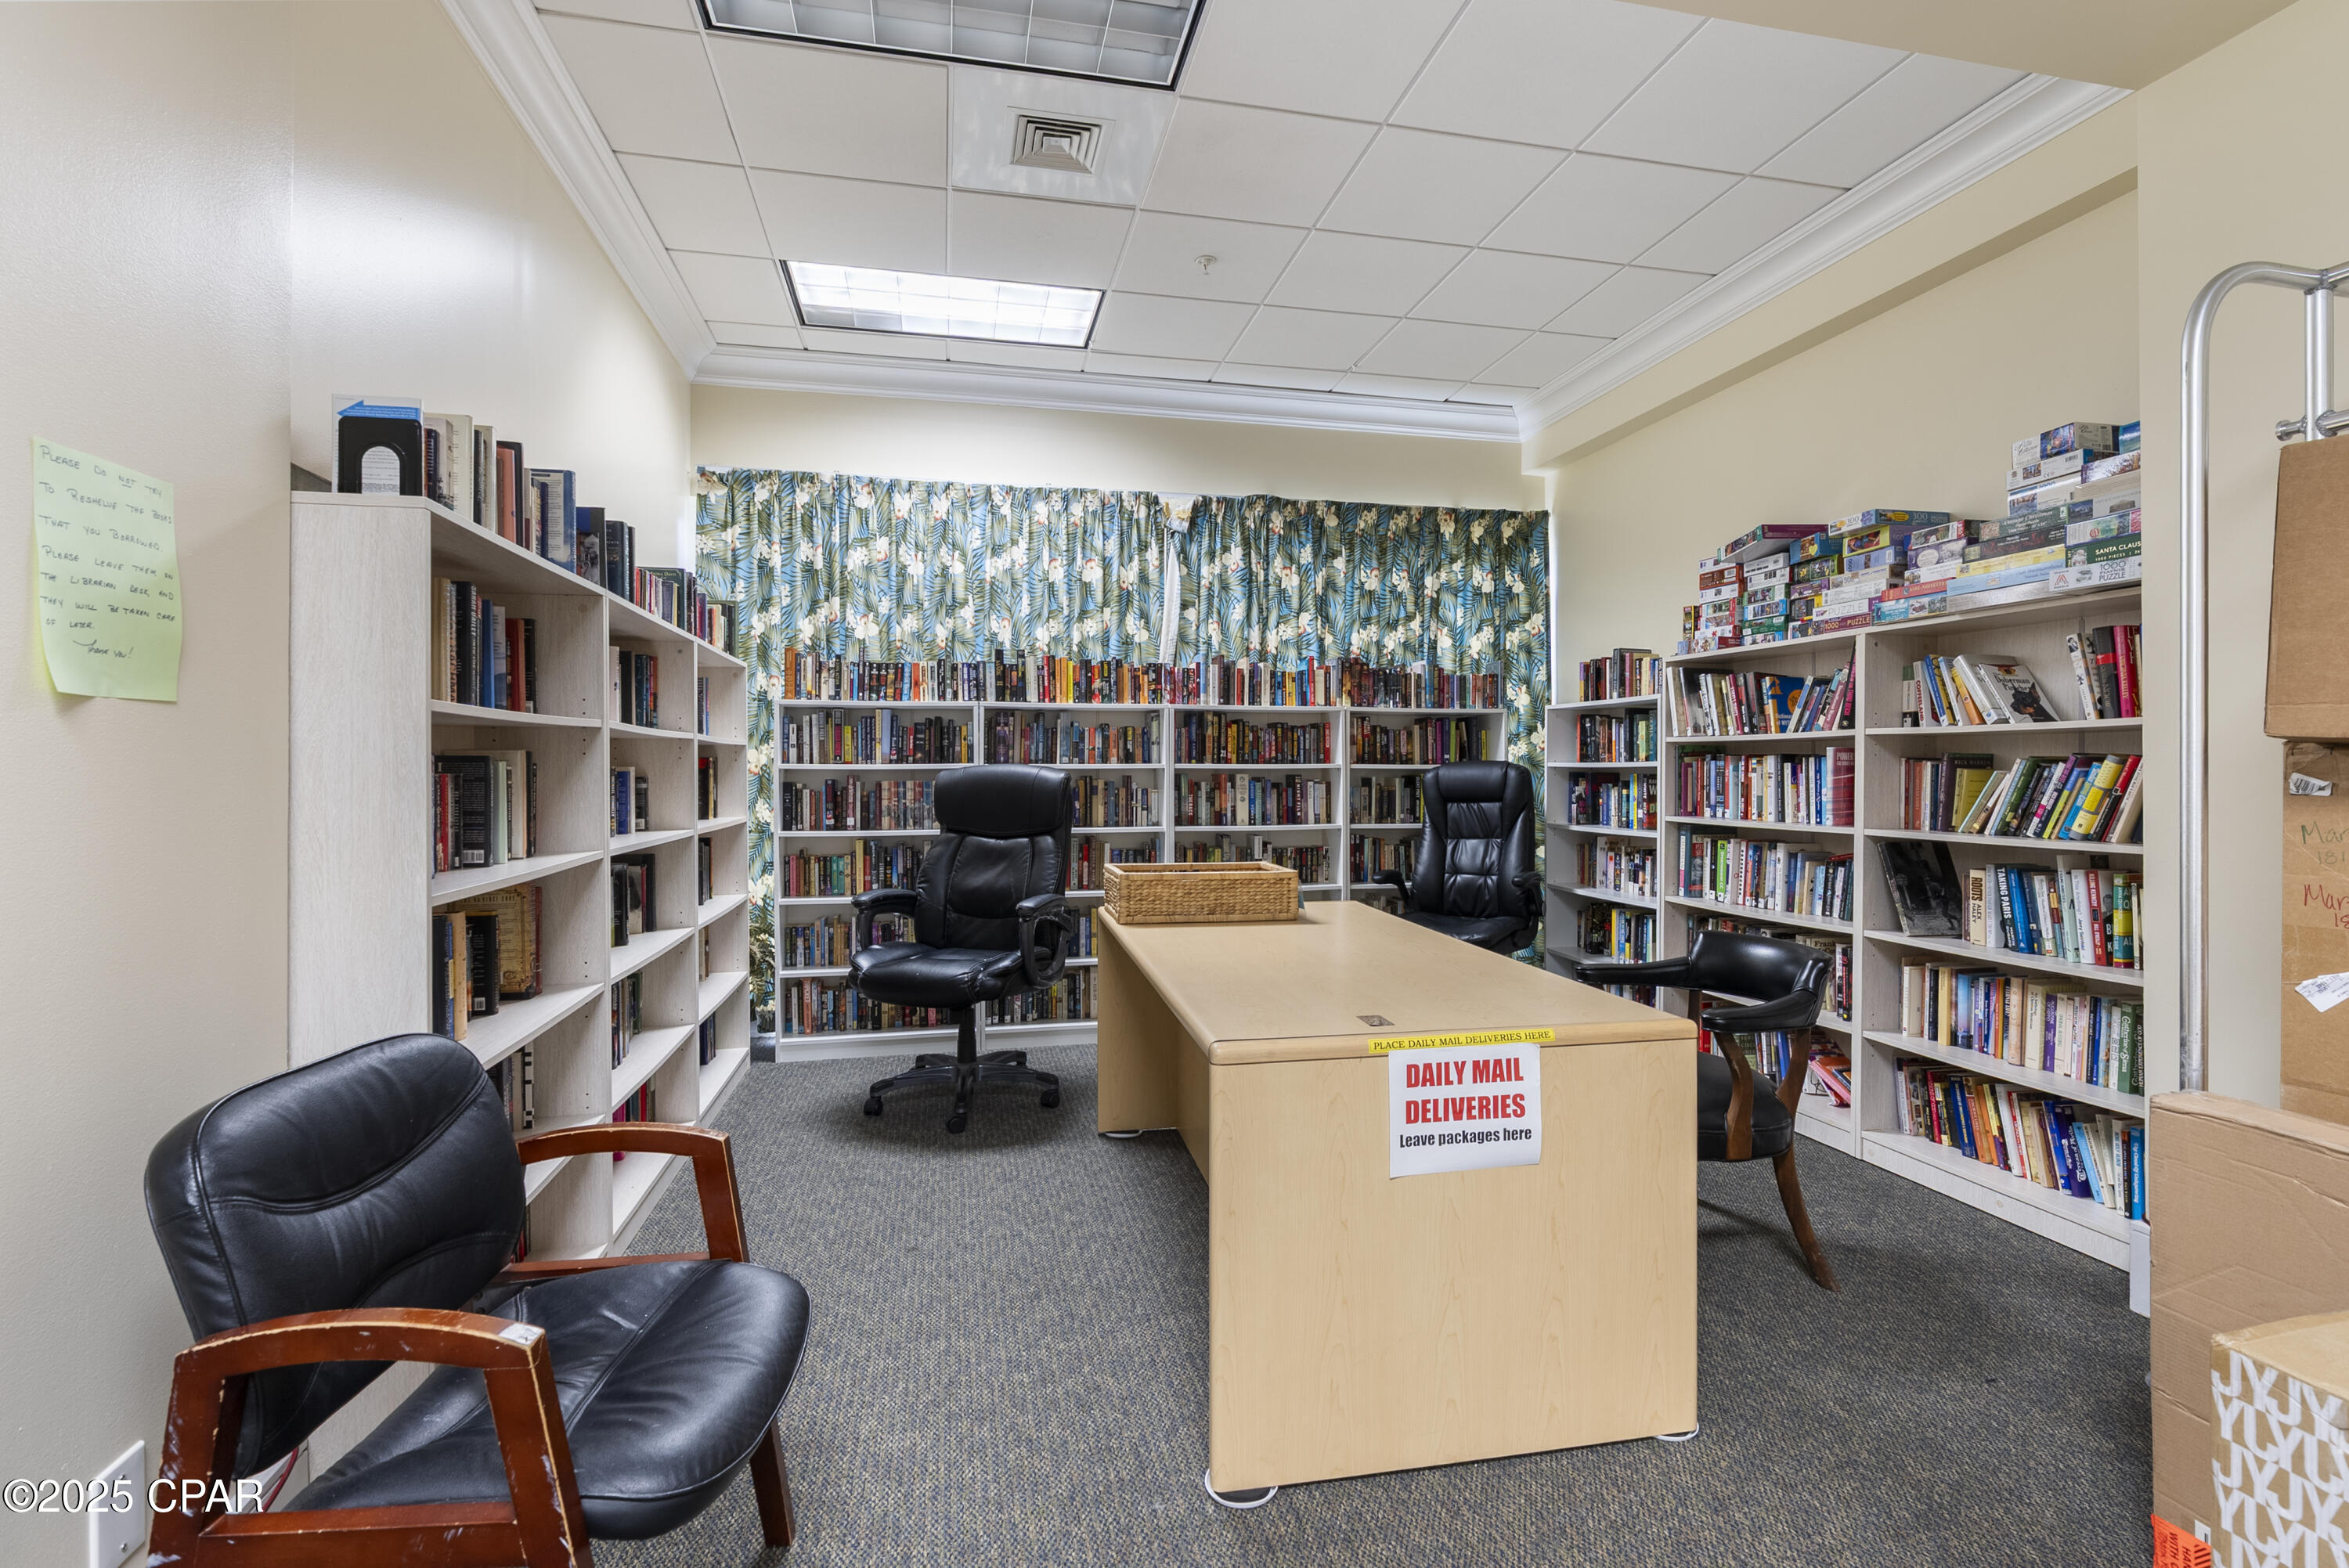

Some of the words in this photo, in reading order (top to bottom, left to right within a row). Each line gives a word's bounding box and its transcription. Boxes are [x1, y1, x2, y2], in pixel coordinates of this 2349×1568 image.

[41, 445, 80, 470] PLEASE
[94, 465, 106, 476] DO
[118, 475, 136, 485] NOT
[145, 486, 162, 497] TRY
[39, 482, 55, 494] TO
[126, 504, 145, 515] THE
[151, 510, 172, 524] BOOKS
[39, 515, 71, 530] THAT
[83, 526, 100, 536] YOU
[1912, 512, 1928, 521] 300
[2095, 546, 2117, 555] SANTA
[2119, 542, 2141, 550] CLAUS
[43, 546, 79, 562] PLEASE
[95, 558, 124, 571] LEAVE
[132, 565, 157, 577] THEM
[2100, 561, 2126, 571] 1000
[41, 572, 56, 582] THE
[70, 575, 116, 589] LIBRARIAN
[159, 590, 174, 600] AND
[2099, 571, 2126, 582] PUZZLE
[40, 596, 63, 608] THEY
[75, 603, 97, 611] WILL
[122, 607, 150, 617] TAKEN
[157, 611, 175, 622] CARE
[1829, 603, 1864, 616] PUZZLE
[1847, 617, 1871, 625] PUZZLE
[1916, 680, 1925, 722] COFFEELAND
[1971, 878, 1983, 901] ROOTS
[1997, 868, 2007, 896] TAKING
[2000, 896, 2012, 918] PARIS
[1374, 1040, 1405, 1050] PLACE
[1408, 1038, 1435, 1048] DAILY
[1439, 1036, 1463, 1046] MAIL
[1465, 1033, 1521, 1044] DELIVERIES
[1525, 1031, 1551, 1040] HERE
[2122, 1016, 2131, 1048] Catherine
[1406, 1061, 1467, 1088] DAILY
[1472, 1058, 1524, 1084] MAIL
[2120, 1053, 2129, 1072] Siena
[1405, 1094, 1526, 1124] DELIVERIES
[1400, 1133, 1435, 1148] Leave
[1438, 1129, 1500, 1146] packages
[1503, 1127, 1532, 1141] here
